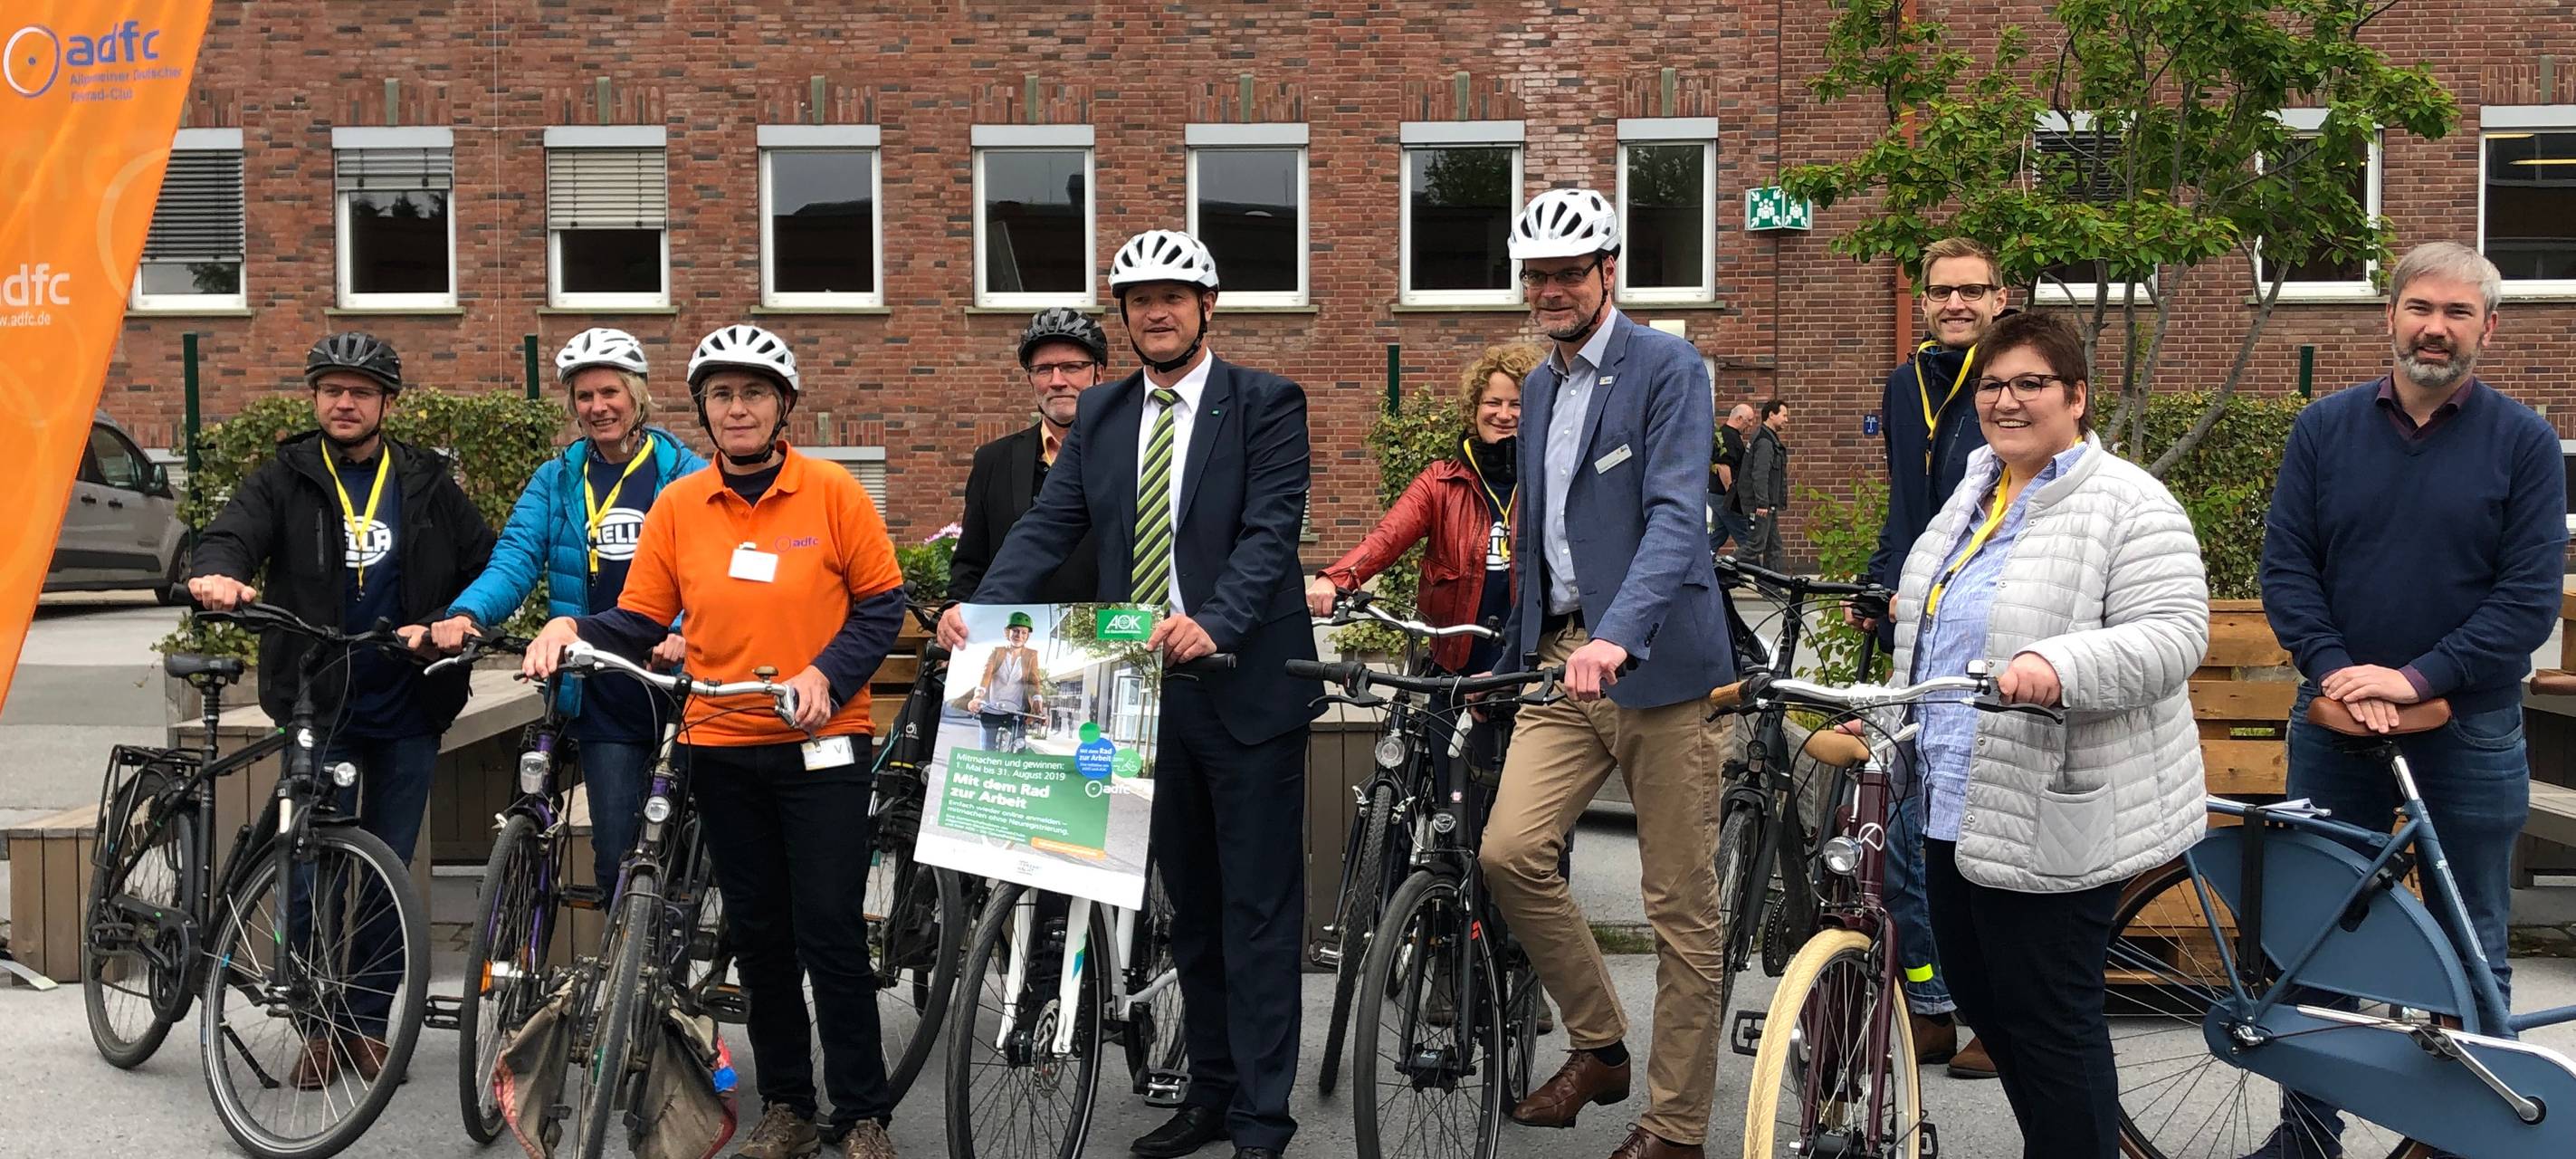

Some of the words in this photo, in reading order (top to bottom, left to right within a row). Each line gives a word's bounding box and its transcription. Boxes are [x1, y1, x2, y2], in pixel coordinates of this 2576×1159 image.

[66, 21, 160, 66] adfc
[0, 263, 71, 307] dfc
[793, 537, 819, 547] adfc
[1106, 614, 1141, 630] AOK
[1091, 754, 1111, 762] Arbeit
[1099, 747, 1112, 755] Rad
[956, 752, 1003, 766] Mitmachen
[1004, 759, 1021, 768] und
[1022, 760, 1064, 771] gewinnen:
[965, 762, 981, 772] Mai
[983, 765, 995, 775] bis
[997, 767, 1009, 777] 31.
[1012, 769, 1042, 781] August
[1044, 771, 1065, 781] 2019
[952, 771, 979, 787] Mit
[982, 778, 1016, 793] dem
[1020, 782, 1050, 799] Rad
[1102, 783, 1131, 794] adfc
[949, 787, 976, 800] zur
[978, 790, 1027, 809] Arbeit
[947, 806, 987, 819] mitmachen
[988, 812, 1007, 823] ohne
[948, 799, 975, 810] Einfach
[977, 803, 1001, 815] wieder
[1001, 809, 1025, 819] online
[1026, 813, 1061, 826] anmelden
